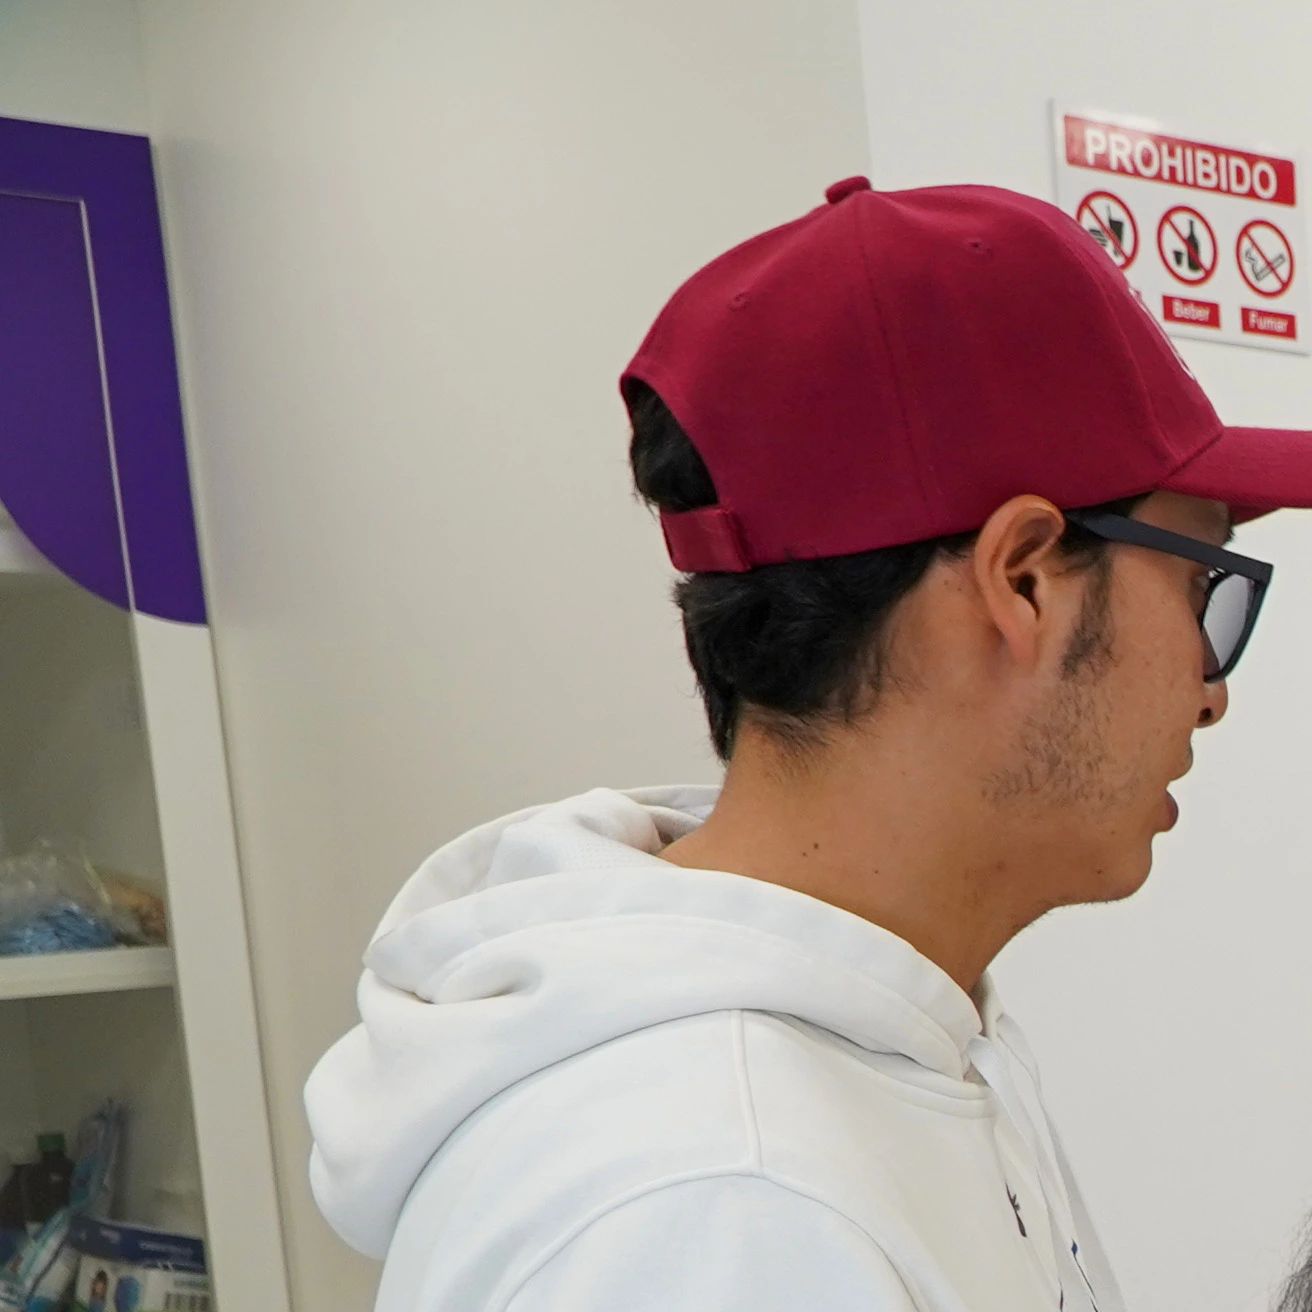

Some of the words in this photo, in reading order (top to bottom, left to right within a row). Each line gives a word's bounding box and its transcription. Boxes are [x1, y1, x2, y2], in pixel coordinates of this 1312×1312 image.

[1083, 126, 1278, 200] PROHIBIDO
[1171, 299, 1211, 322] Beber
[1249, 311, 1288, 333] Fumar
